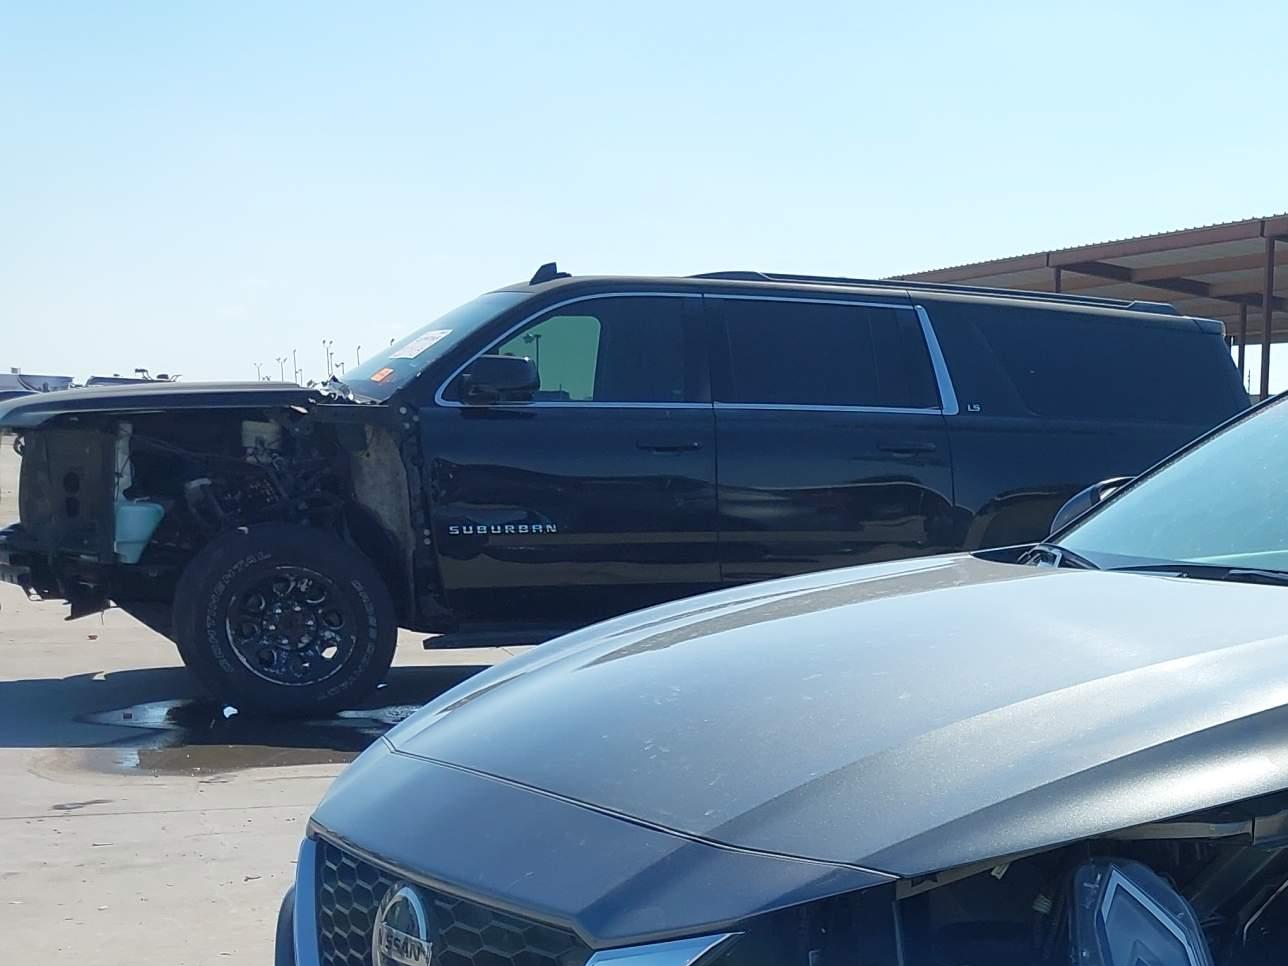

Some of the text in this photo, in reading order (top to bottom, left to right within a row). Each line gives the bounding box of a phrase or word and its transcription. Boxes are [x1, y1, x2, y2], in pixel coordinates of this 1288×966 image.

[967, 403, 981, 412] LS
[448, 524, 557, 535] SUBURBAN
[378, 924, 426, 963] ISSAN
